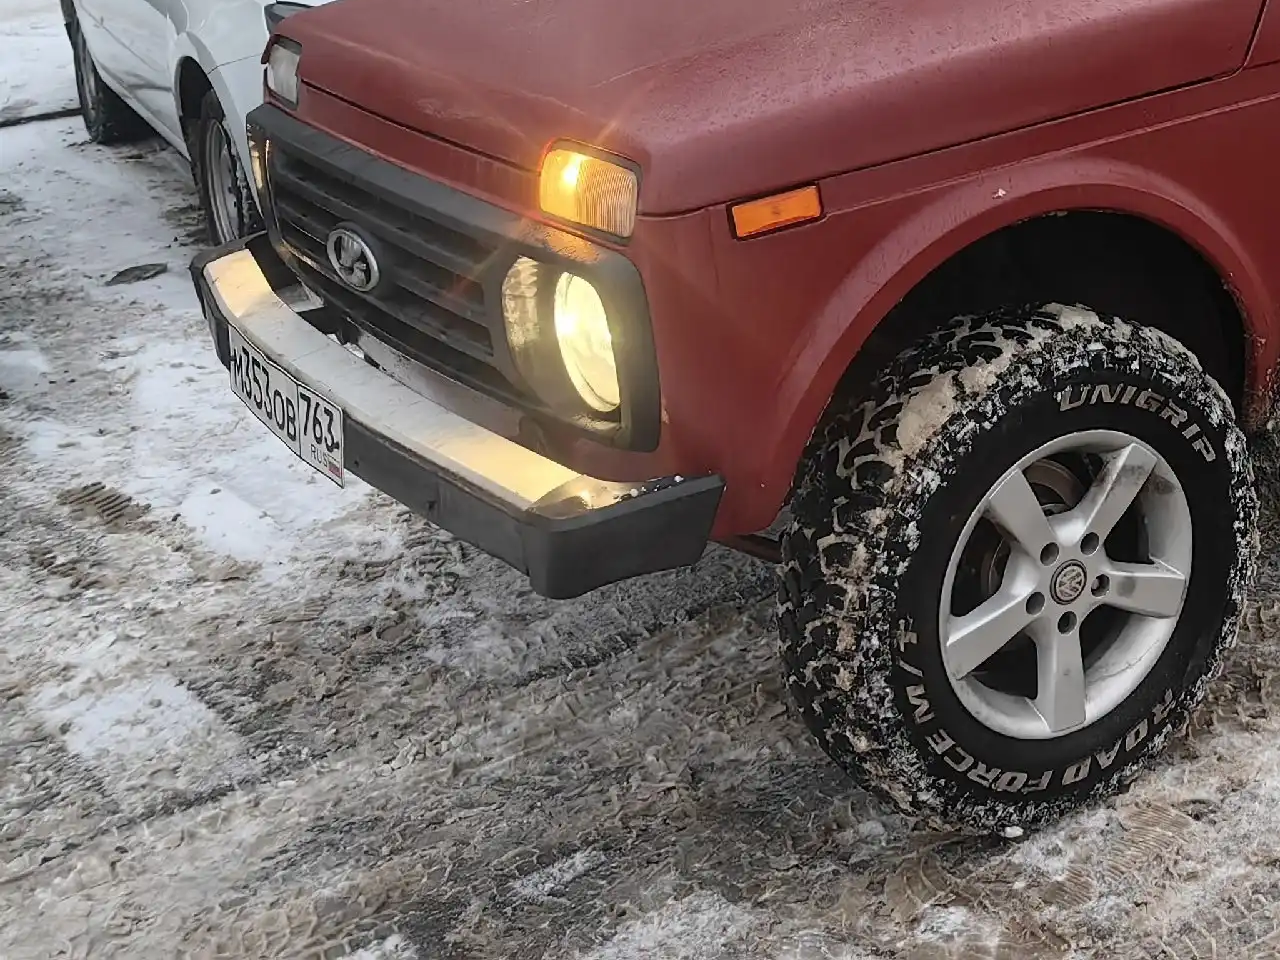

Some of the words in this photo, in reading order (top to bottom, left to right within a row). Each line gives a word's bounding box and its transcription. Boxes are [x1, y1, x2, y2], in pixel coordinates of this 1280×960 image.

[300, 391, 340, 453] 763
[1058, 381, 1217, 463] UNIGRIP
[310, 443, 328, 468] RUS
[925, 727, 1054, 792] FORCE
